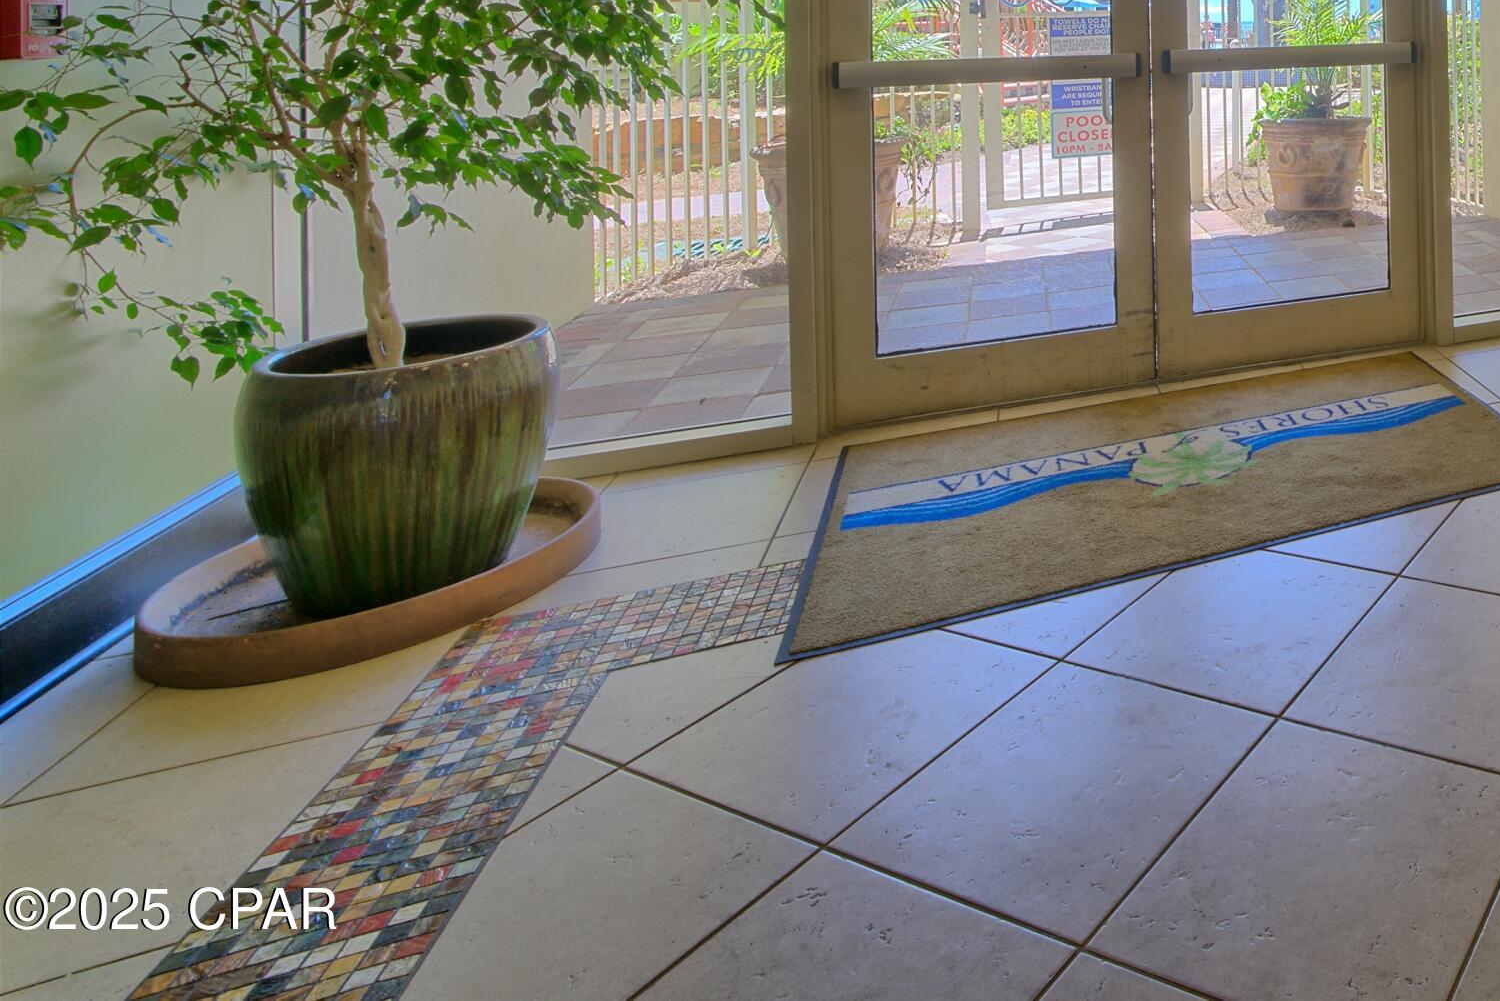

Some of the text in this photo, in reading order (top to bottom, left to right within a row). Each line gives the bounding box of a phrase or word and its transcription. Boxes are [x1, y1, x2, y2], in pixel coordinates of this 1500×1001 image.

[1063, 85, 1102, 93] WRISTBAN
[1066, 115, 1103, 128] POO
[1057, 128, 1112, 143] CLOSE
[1056, 144, 1086, 154] 10PM
[1097, 142, 1112, 151] 8A
[1219, 396, 1389, 439] SHORES
[938, 440, 1148, 493] PANAMA
